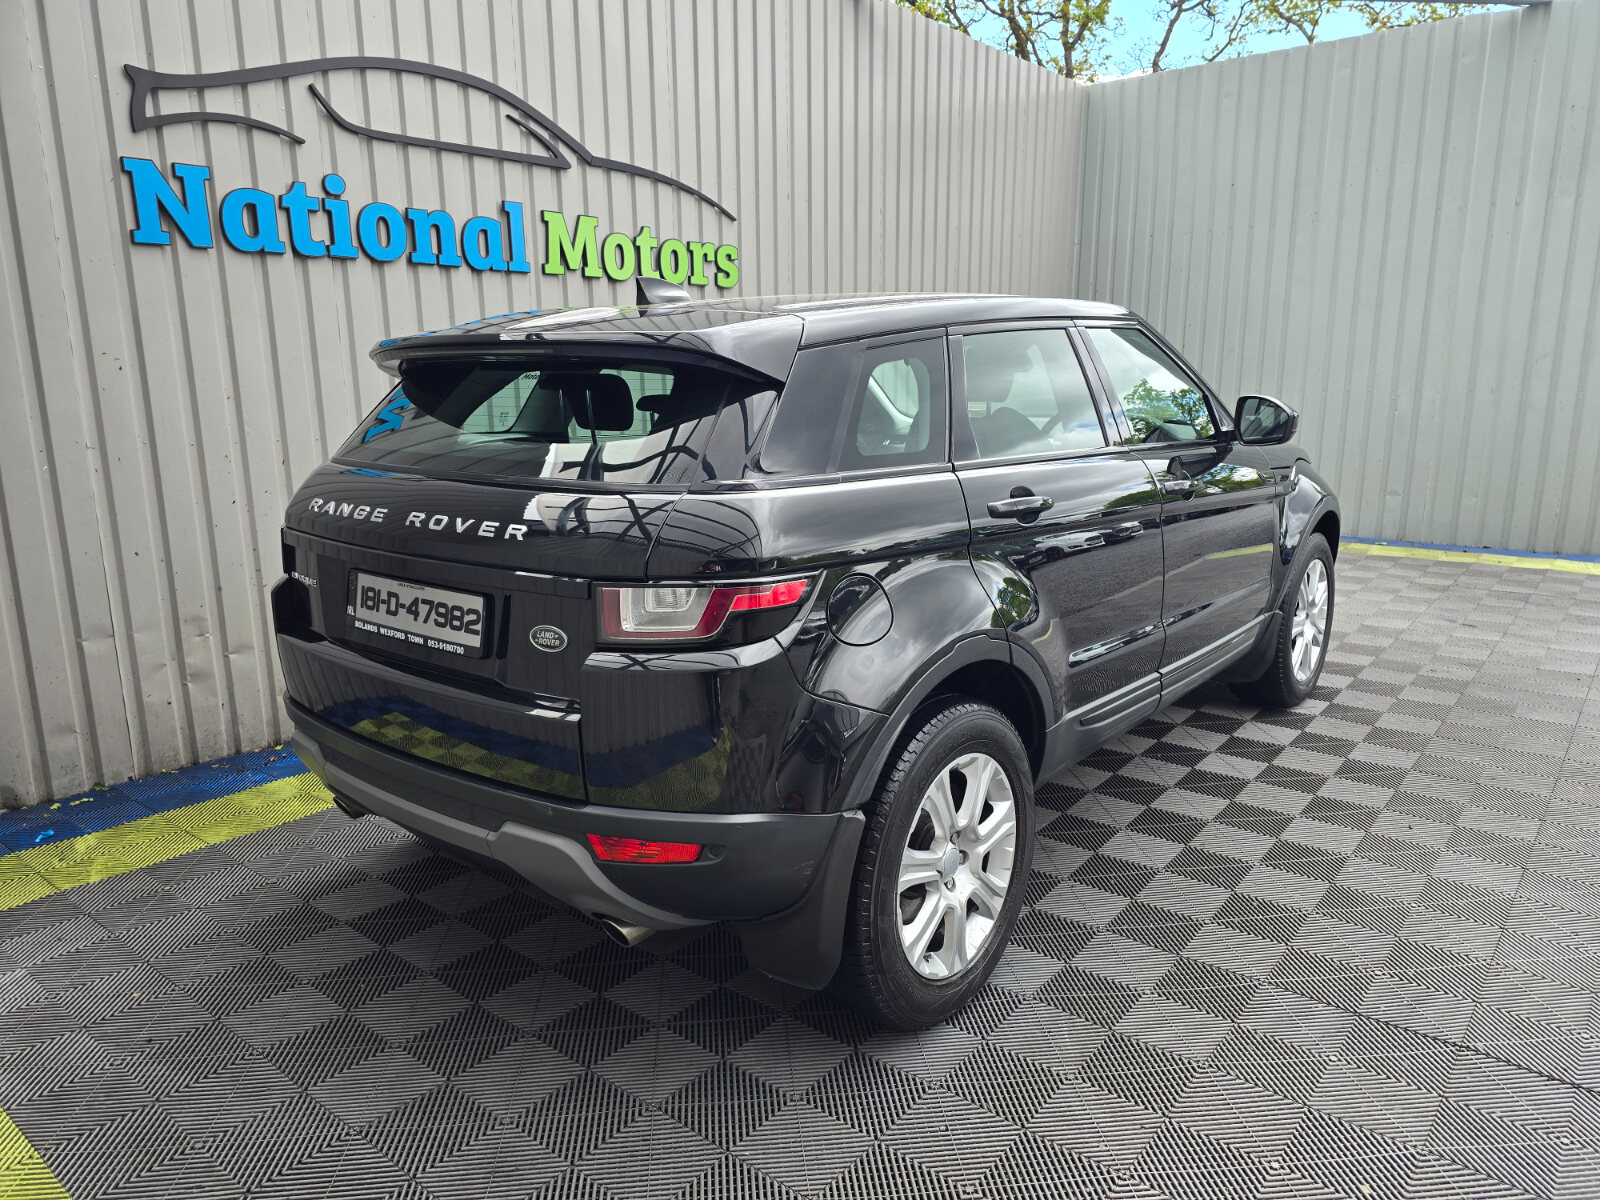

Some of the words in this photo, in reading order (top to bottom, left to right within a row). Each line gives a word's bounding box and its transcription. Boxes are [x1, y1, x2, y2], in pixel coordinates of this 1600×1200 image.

[120, 156, 531, 273] National
[542, 210, 739, 288] Motors
[308, 498, 389, 523] RANGE
[405, 511, 528, 541] ROVER
[355, 620, 378, 634] BOLANDS
[380, 627, 406, 640] WEXFORD
[407, 634, 424, 645] TOWN
[360, 585, 481, 636] 181-D-47982
